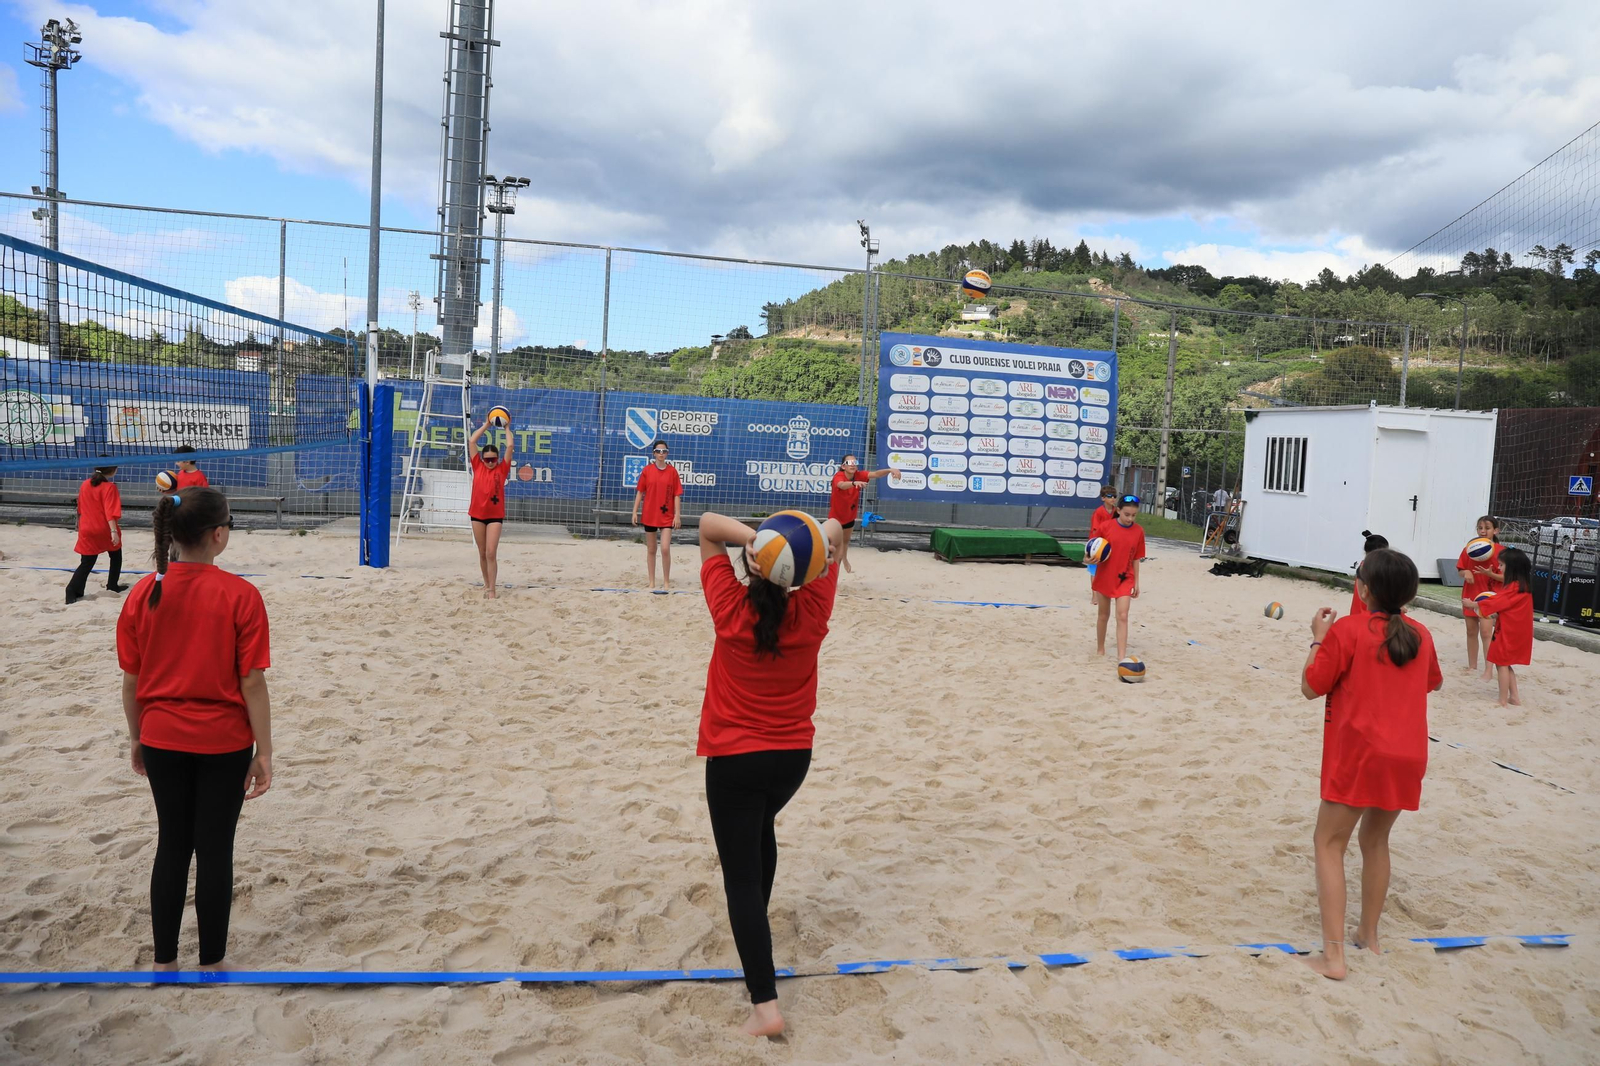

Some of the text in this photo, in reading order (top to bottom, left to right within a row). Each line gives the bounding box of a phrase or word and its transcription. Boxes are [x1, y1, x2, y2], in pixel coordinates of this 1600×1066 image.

[949, 354, 1062, 372] CLUB OURENSE VOLEI PRAIA
[159, 406, 231, 419] Concello de
[661, 411, 717, 423] DEPORTE
[159, 421, 243, 437] OURENSE
[660, 422, 711, 434] GALEGO
[679, 473, 715, 485] ALICIA
[1572, 576, 1595, 584] elksport
[1580, 607, 1593, 617] 50
